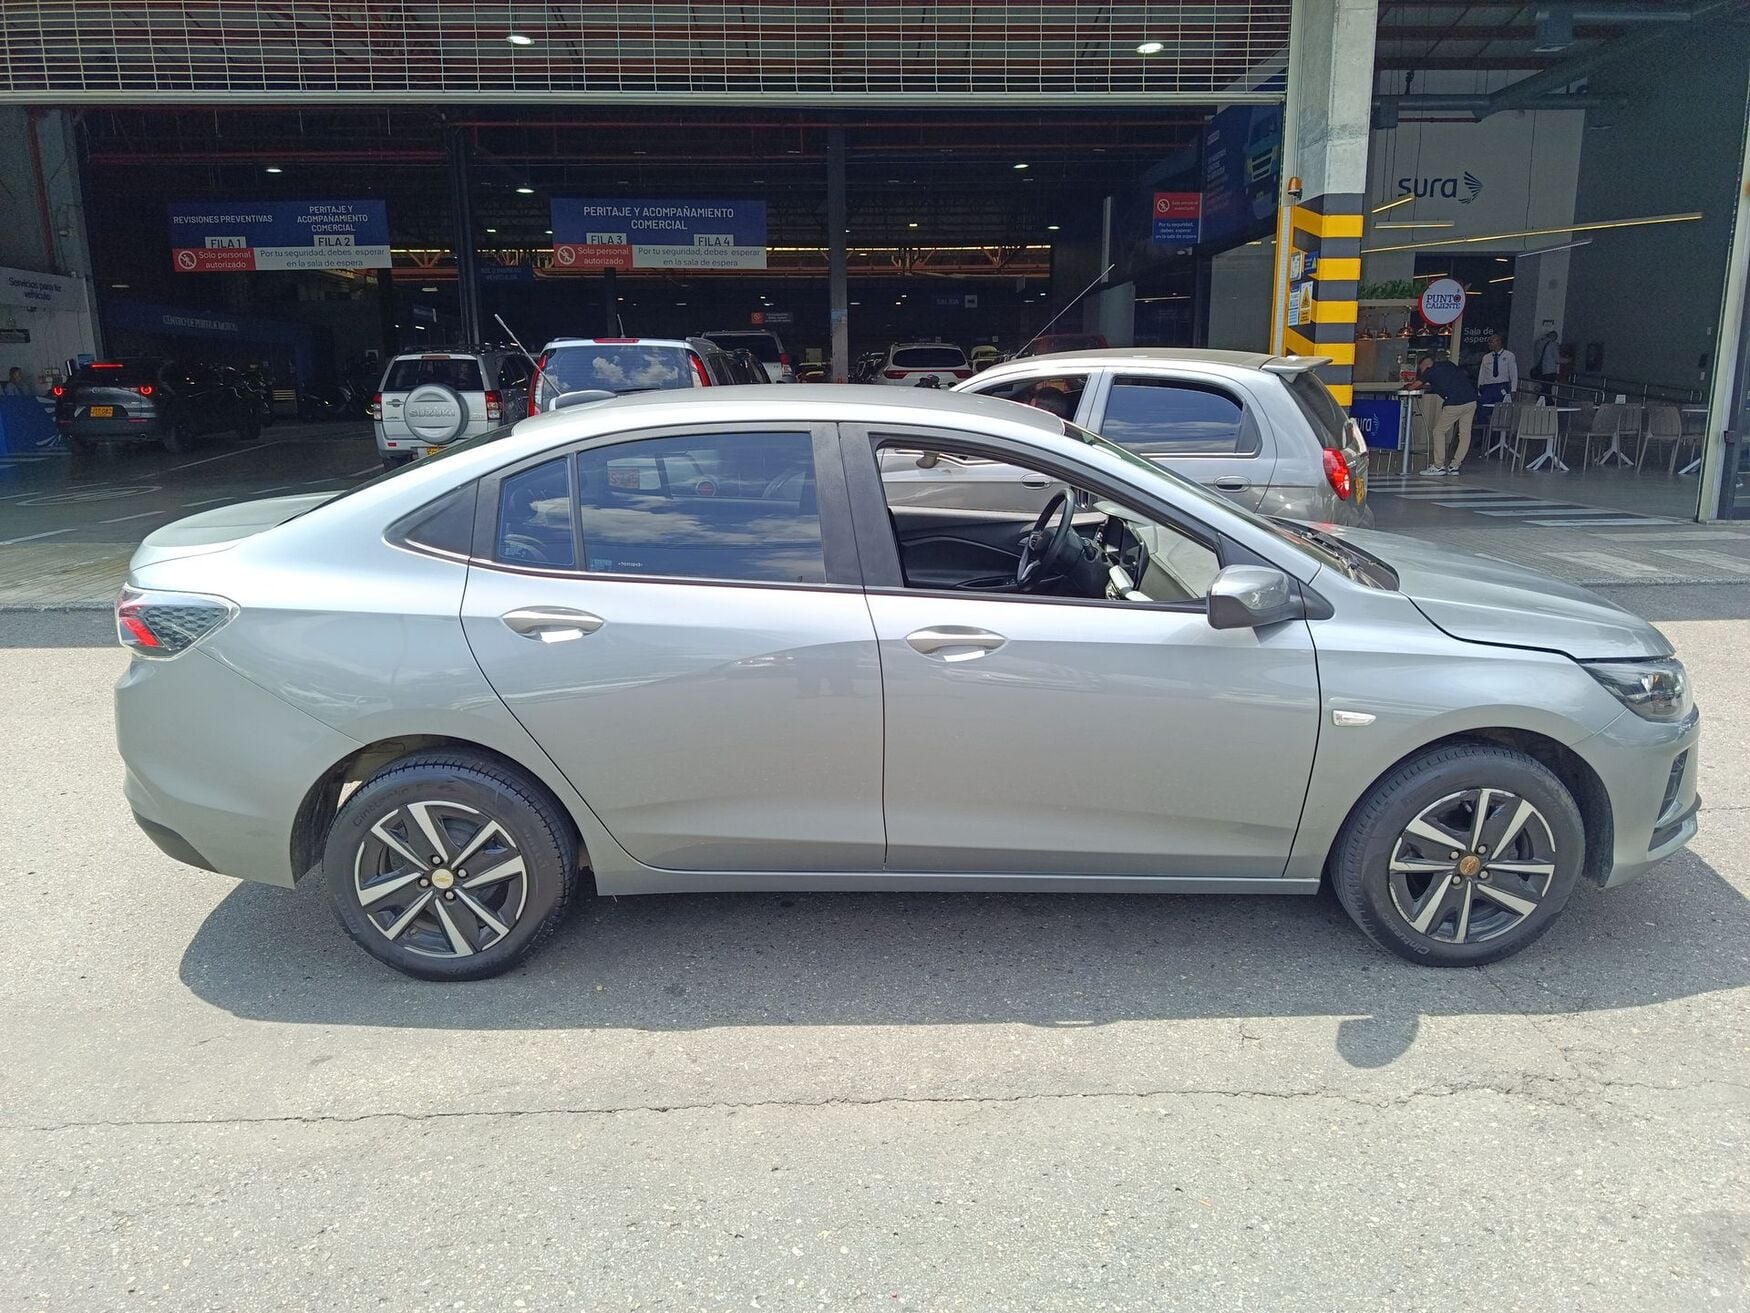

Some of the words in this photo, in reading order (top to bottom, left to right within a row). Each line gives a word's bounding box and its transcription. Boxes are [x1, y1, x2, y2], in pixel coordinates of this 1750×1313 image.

[1398, 178, 1457, 198] sura
[309, 206, 347, 214] PERITAJE
[348, 205, 353, 213] Y
[583, 206, 631, 217] PERITAJE
[633, 207, 640, 217] Y
[642, 206, 734, 218] ACOMPAÑAMIENTO
[173, 216, 219, 224] REVISIONES
[220, 214, 273, 223] PREVENTIVAS
[297, 213, 368, 223] ACOMPAÑAMIENTO
[311, 224, 356, 232] COMERCIAL
[630, 219, 688, 230] COMERCIAL
[211, 239, 233, 249] FILA
[318, 237, 342, 247] FILA
[344, 238, 351, 247] 2
[591, 235, 615, 245] FILA
[616, 235, 623, 245] 3
[698, 237, 722, 247] FILA
[724, 238, 730, 247] 4
[198, 251, 214, 259] Solo
[217, 251, 251, 261] personal
[284, 249, 326, 259] seguridad,
[327, 248, 352, 256] debes
[355, 248, 385, 257] esperar
[577, 247, 594, 255] Solo
[596, 247, 629, 257] personal
[662, 248, 703, 257] seguridad,
[704, 248, 728, 256] debes
[731, 250, 760, 258] esperar
[299, 259, 306, 267] la
[307, 259, 323, 267] sala
[324, 259, 335, 267] de
[336, 260, 364, 268] espera
[584, 257, 624, 265] autorizado
[675, 258, 682, 266] la
[683, 258, 699, 266] sala
[712, 260, 738, 268] espera
[1426, 294, 1462, 303] PUNTO
[1426, 302, 1461, 310] CALIENTE
[1463, 327, 1481, 336] Sala
[1483, 327, 1494, 335] de
[1463, 336, 1488, 344] esper
[408, 408, 456, 418] SUZUKI
[1355, 417, 1373, 432] ura
